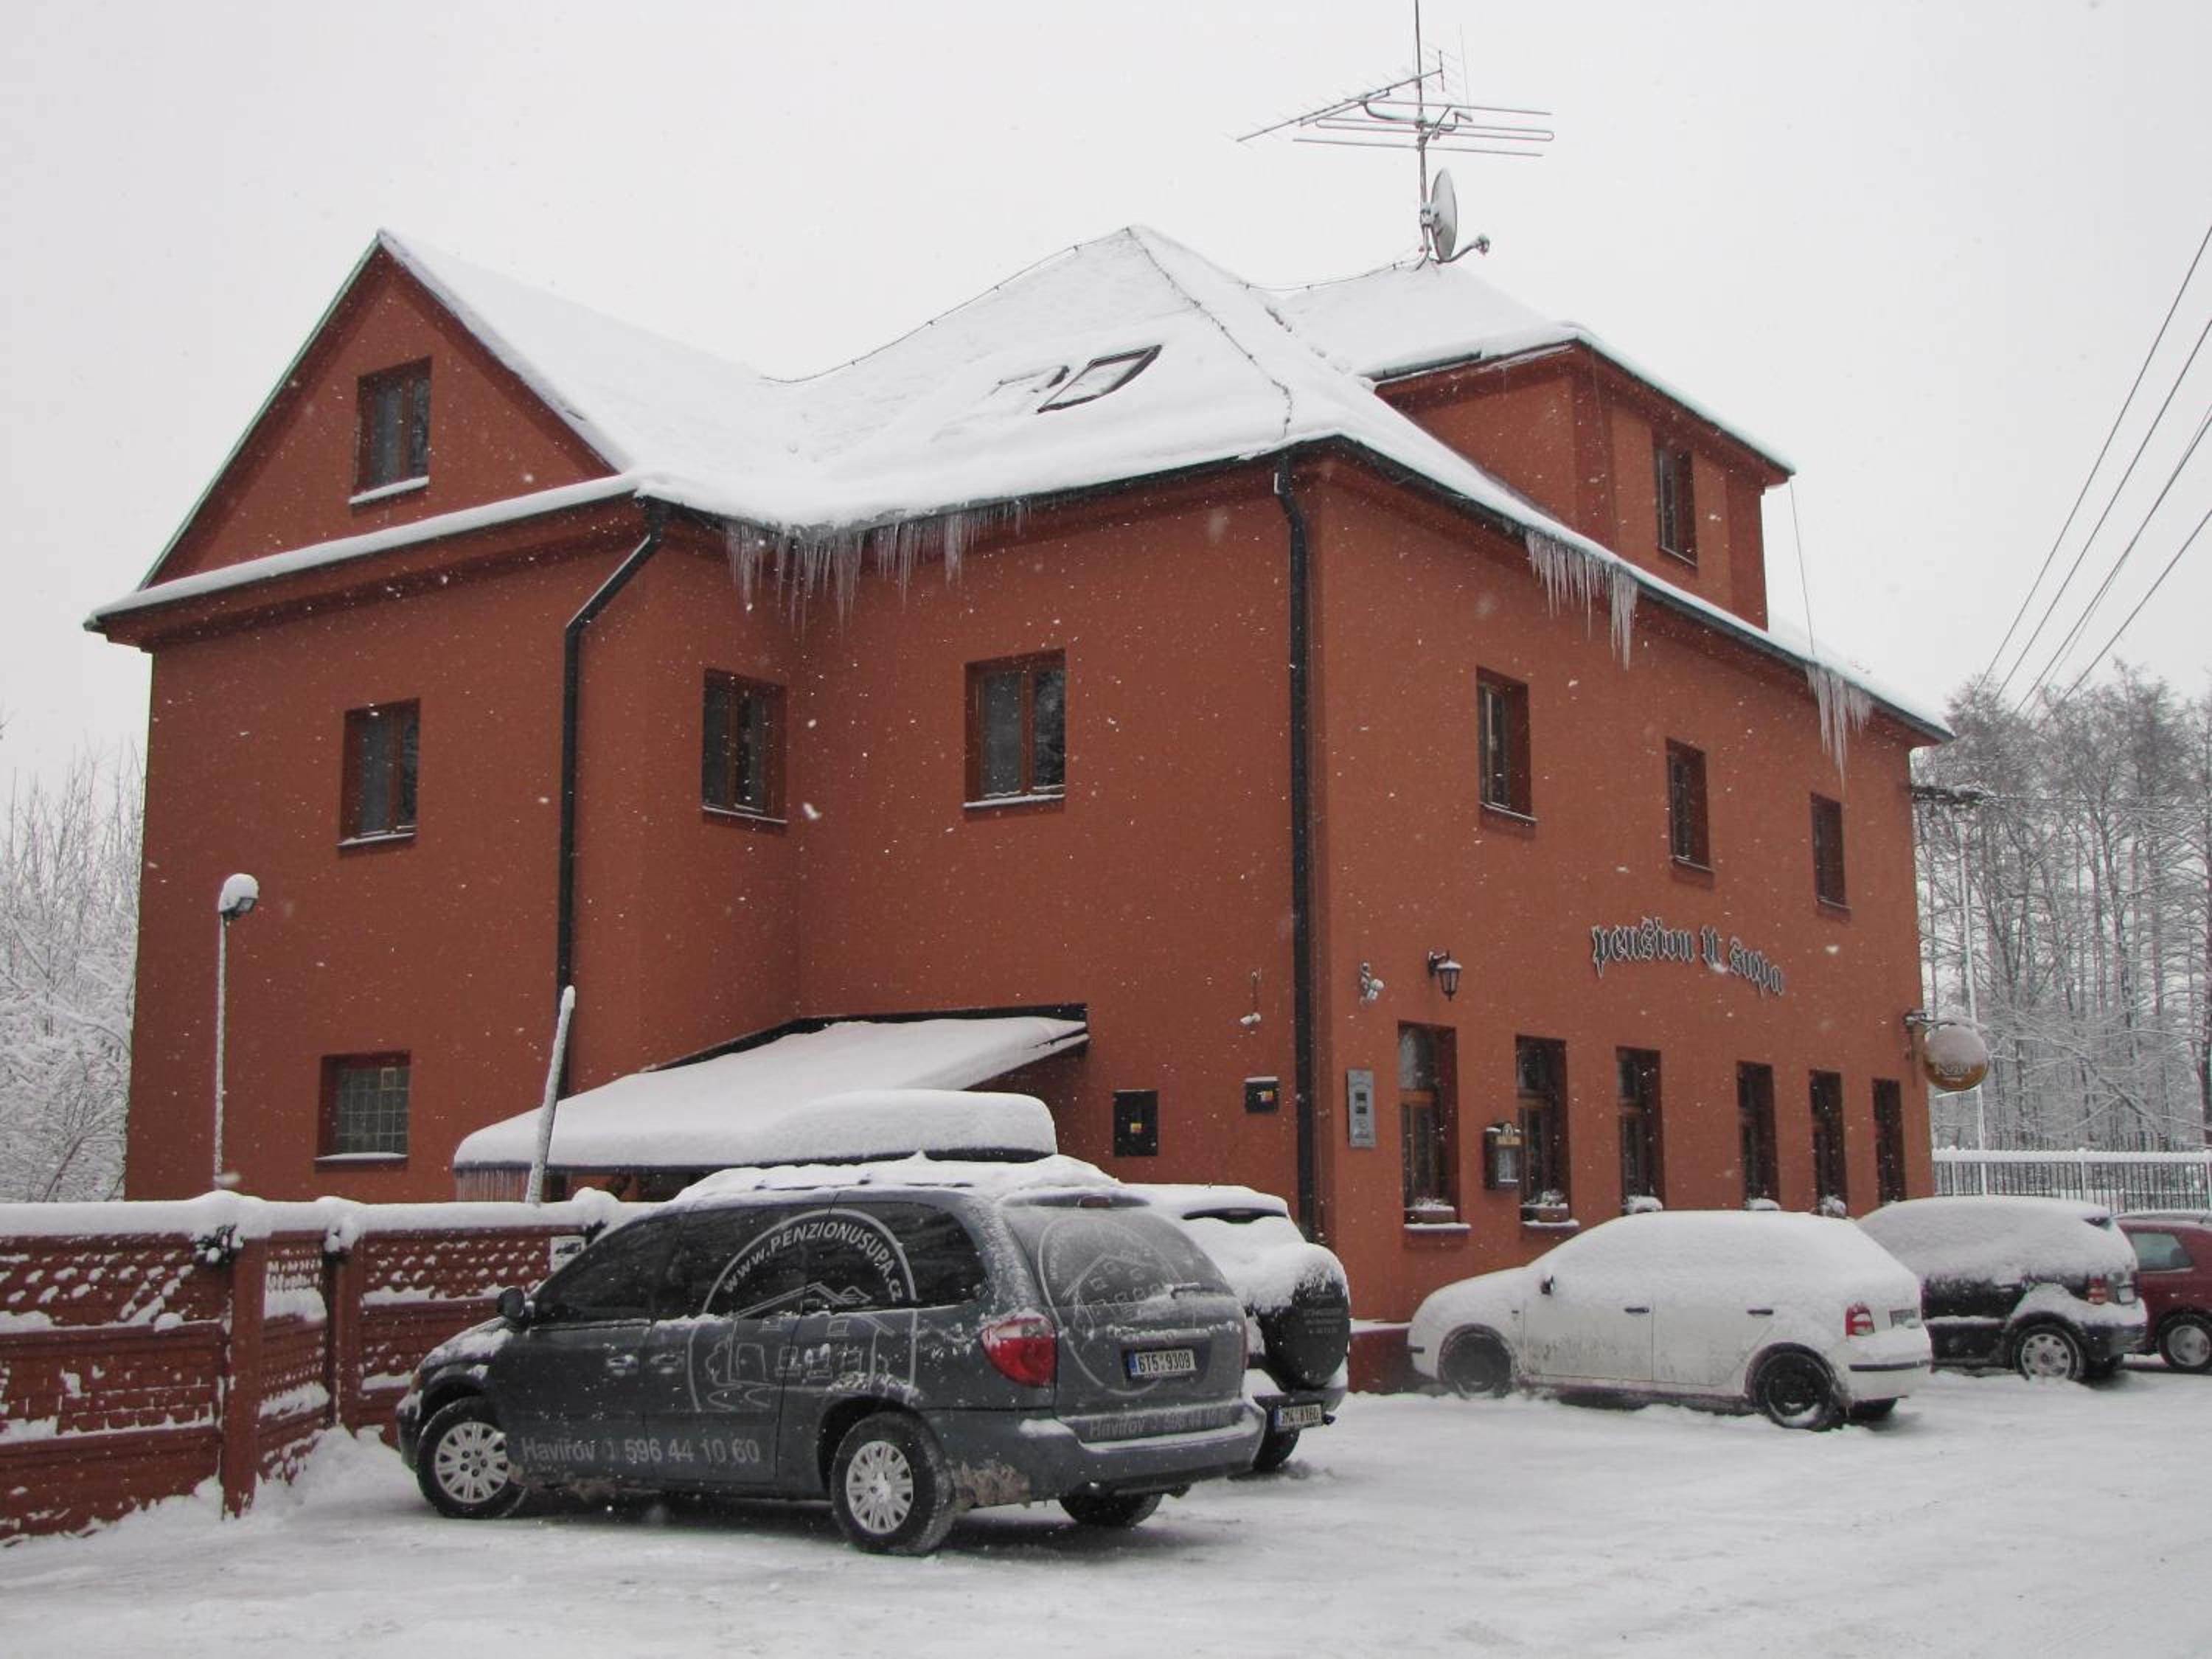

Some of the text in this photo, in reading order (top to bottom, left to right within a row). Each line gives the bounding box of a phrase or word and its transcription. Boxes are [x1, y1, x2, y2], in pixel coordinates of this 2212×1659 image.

[625, 1437, 662, 1464] 596
[668, 1438, 695, 1463] 44
[700, 1438, 727, 1464] 10
[731, 1438, 760, 1464] 60
